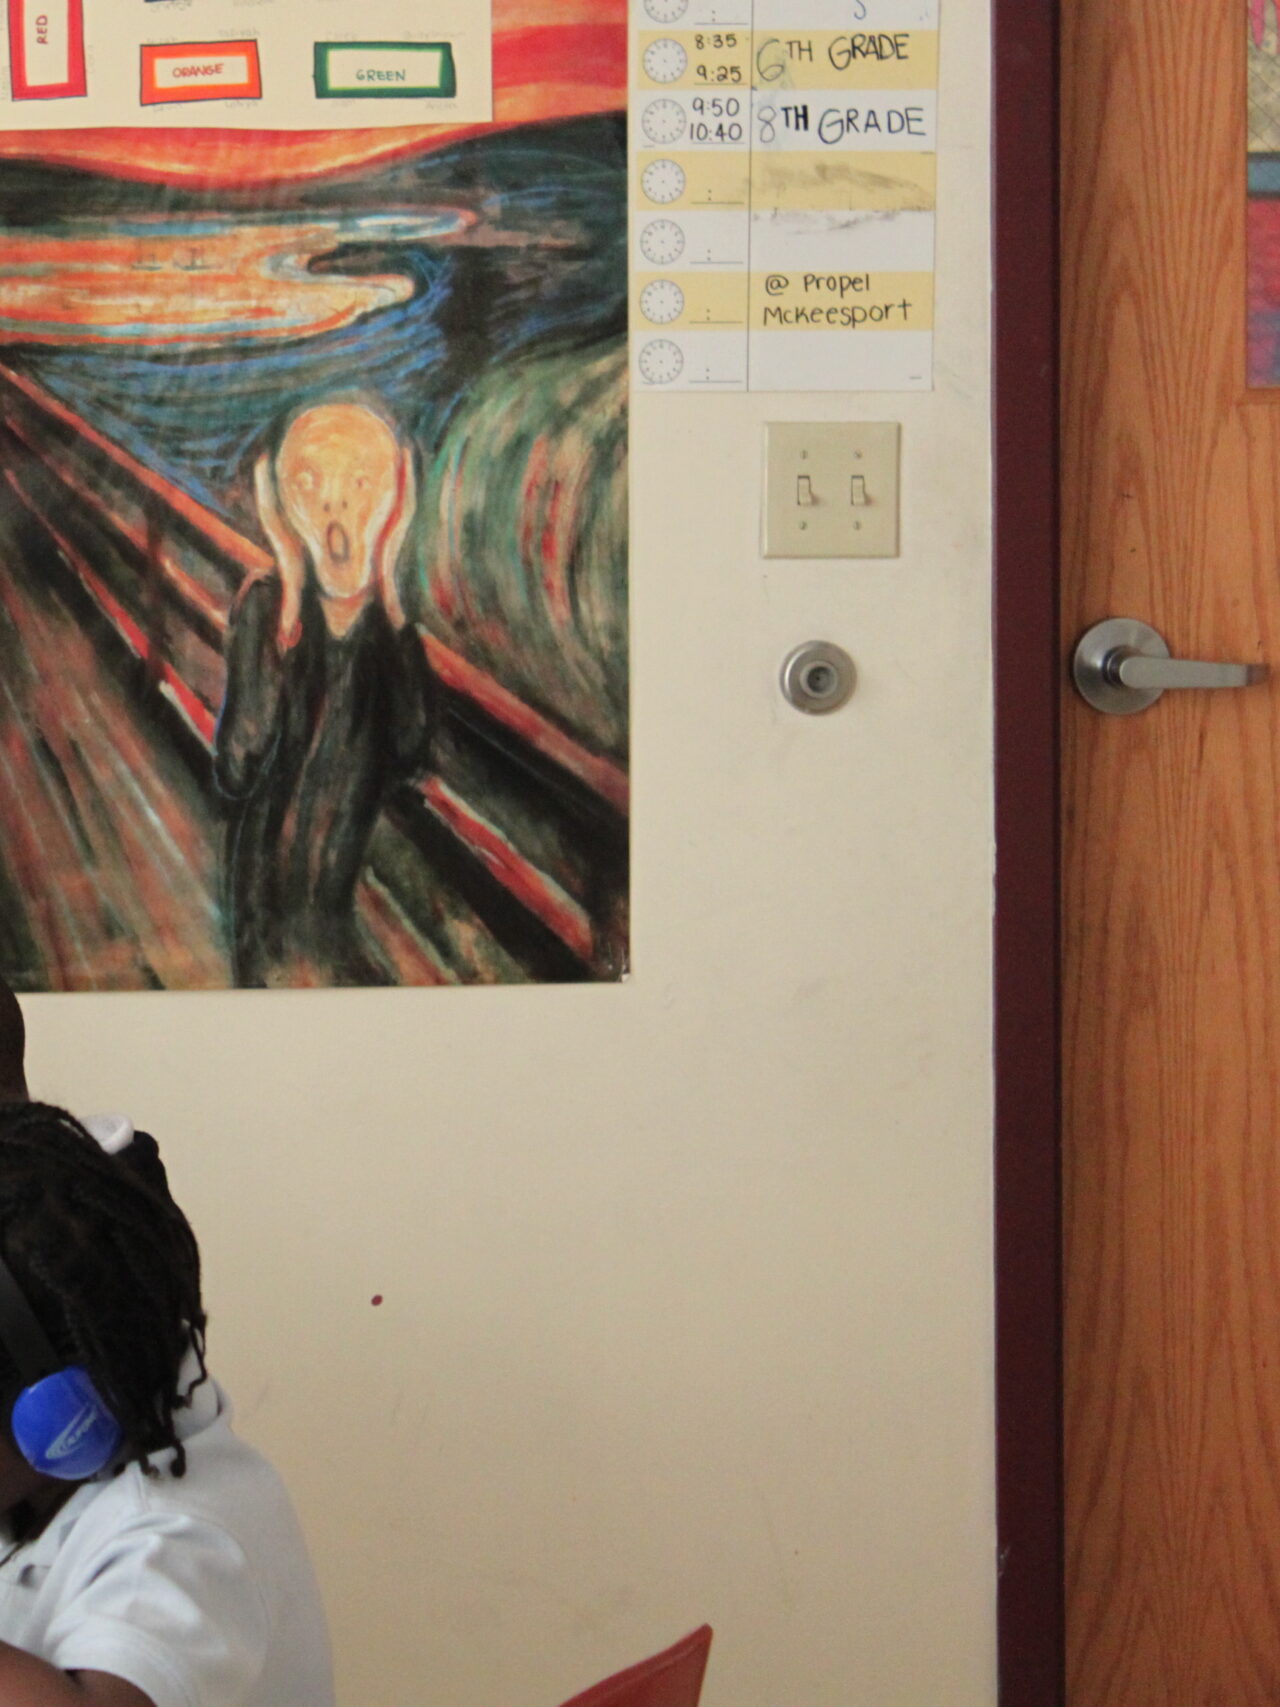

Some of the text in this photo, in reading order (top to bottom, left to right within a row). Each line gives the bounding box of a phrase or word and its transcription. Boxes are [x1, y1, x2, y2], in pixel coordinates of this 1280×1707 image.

[35, 14, 48, 45] RED
[694, 33, 738, 50] 8:35
[756, 33, 911, 82] 6TH GRADE
[171, 62, 225, 79] ORANGE
[355, 68, 407, 82] GREEN
[695, 65, 742, 84] 9:25
[692, 97, 740, 116] 9:50
[689, 122, 743, 142] 10:40
[756, 104, 927, 145] 8TH GRADE
[765, 273, 871, 299] @ Propel
[762, 298, 913, 329] McKeesport
